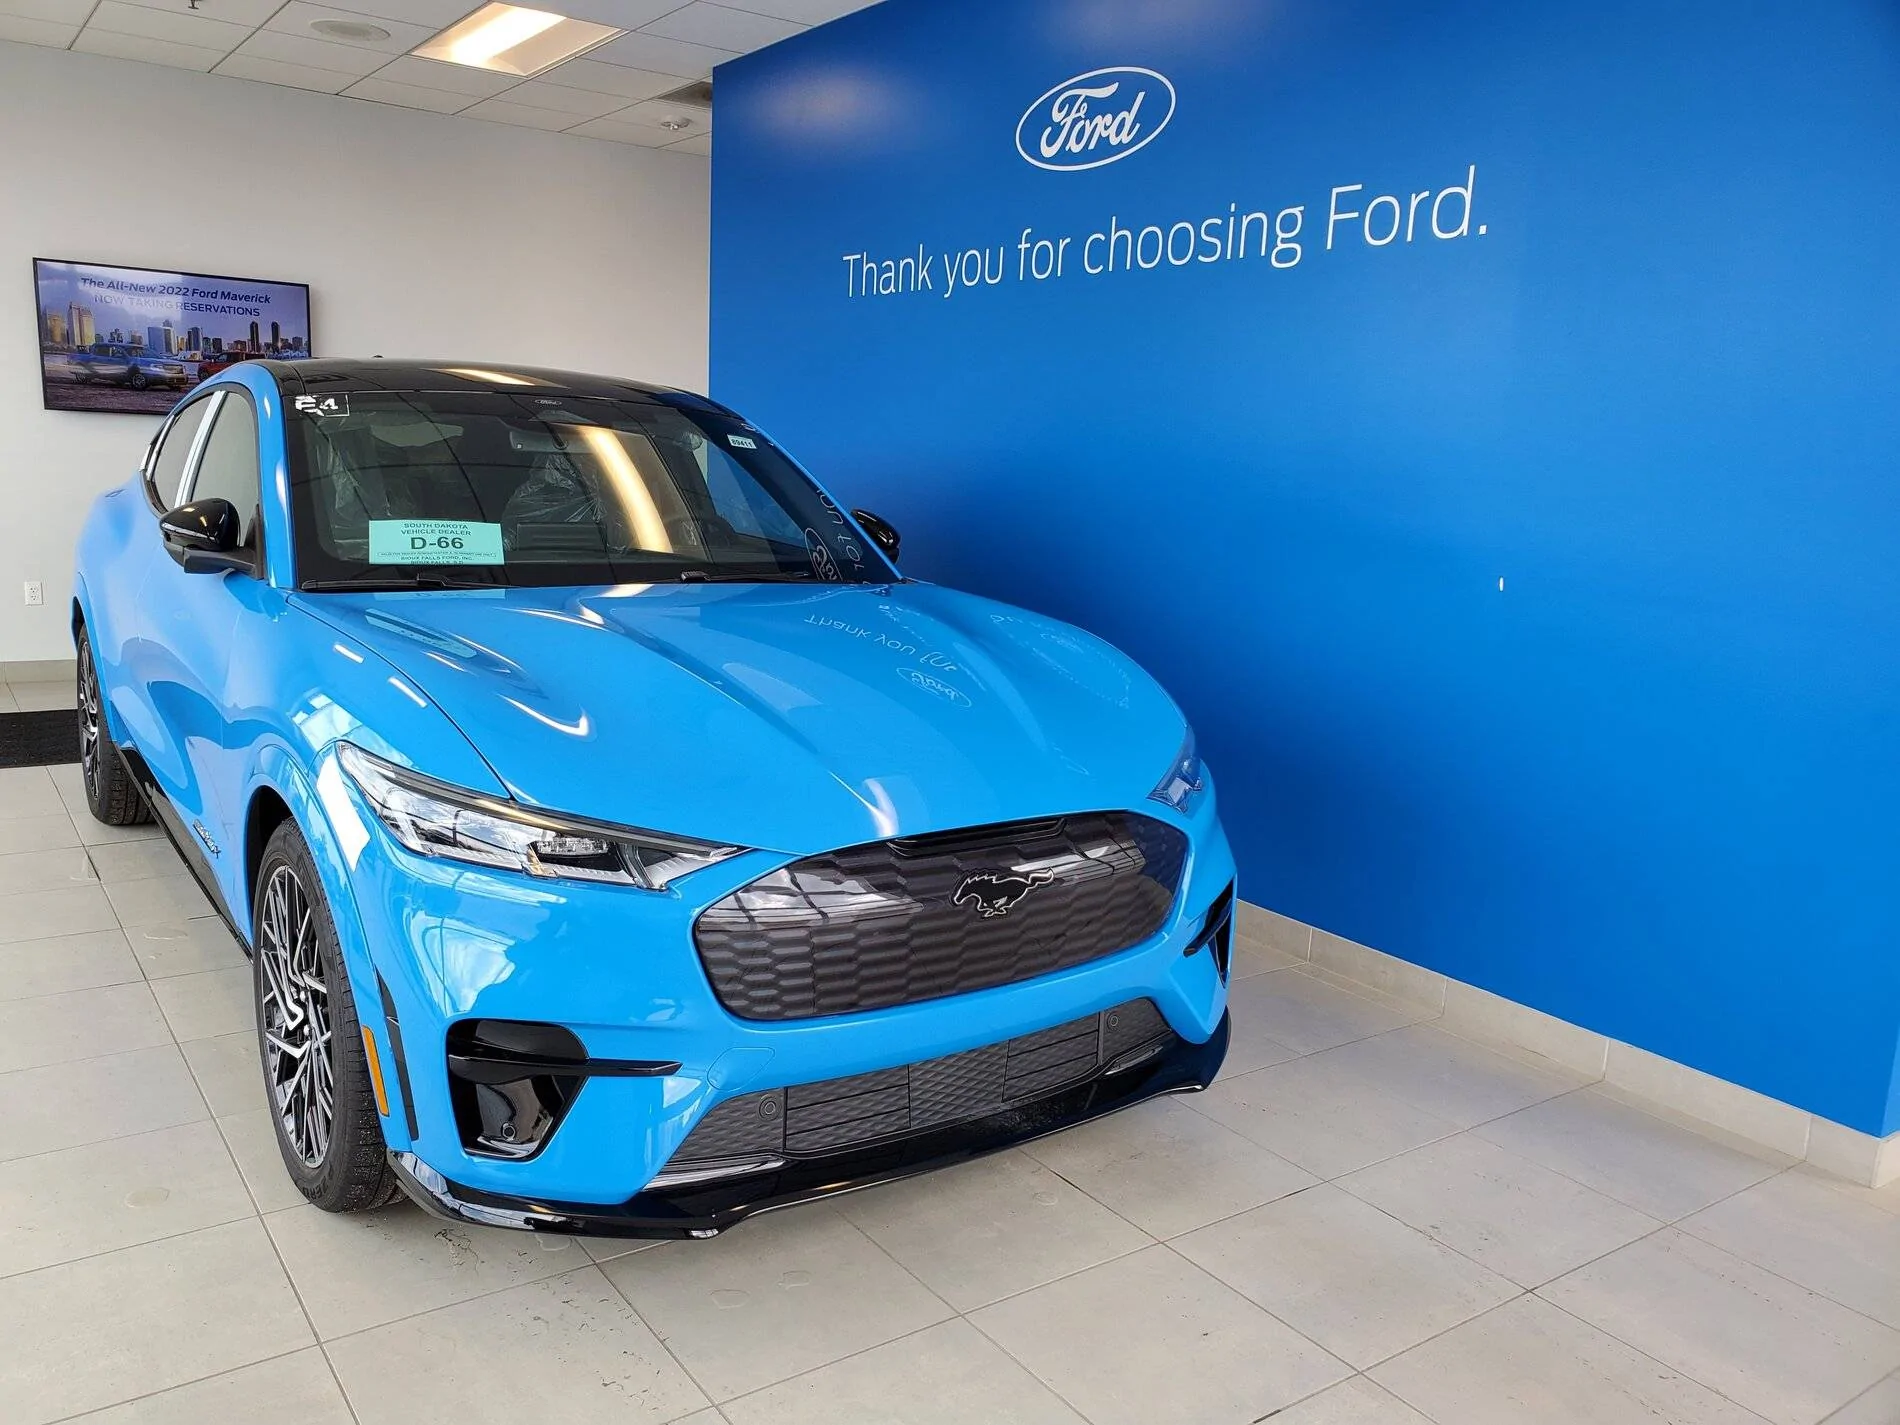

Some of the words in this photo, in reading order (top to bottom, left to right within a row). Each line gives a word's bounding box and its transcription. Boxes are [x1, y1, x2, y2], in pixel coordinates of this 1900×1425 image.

[1040, 82, 1147, 157] Ford
[842, 243, 933, 298] Thank
[943, 247, 1004, 298] you
[1017, 228, 1071, 281] for
[1083, 203, 1306, 274] choosing
[1326, 165, 1488, 250] Ford.
[80, 277, 105, 289] The
[107, 281, 157, 294] All-New
[158, 285, 191, 297] 2022
[191, 288, 219, 300] Ford
[221, 291, 271, 304] Maverick
[94, 295, 125, 305] NOW
[128, 297, 174, 309] TAKING
[175, 302, 261, 317] RESERVATIONS
[410, 536, 464, 549] D-66
